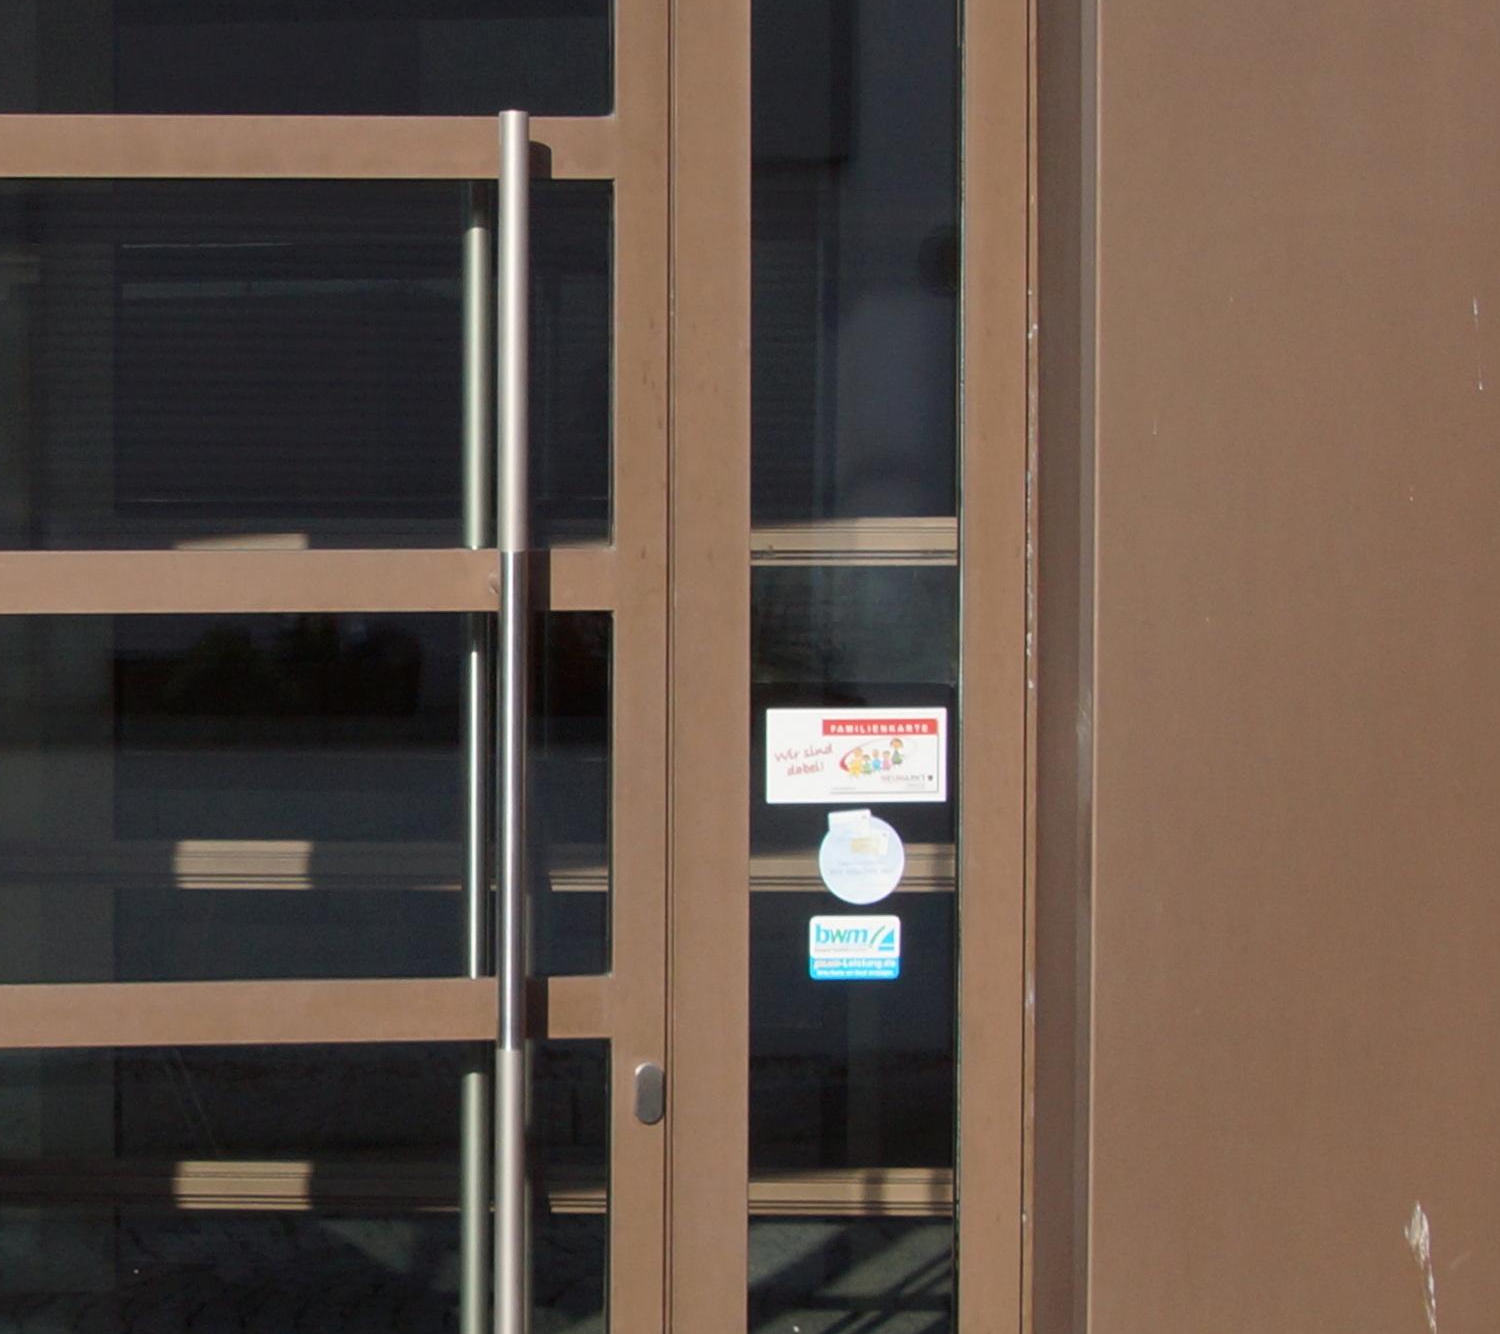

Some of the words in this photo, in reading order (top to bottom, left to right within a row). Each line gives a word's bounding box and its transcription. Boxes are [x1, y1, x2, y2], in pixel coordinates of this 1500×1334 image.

[829, 723, 929, 734] FAMILIENKARTE
[774, 750, 800, 762] Wir
[804, 743, 833, 759] sind
[815, 923, 869, 943] bwm
